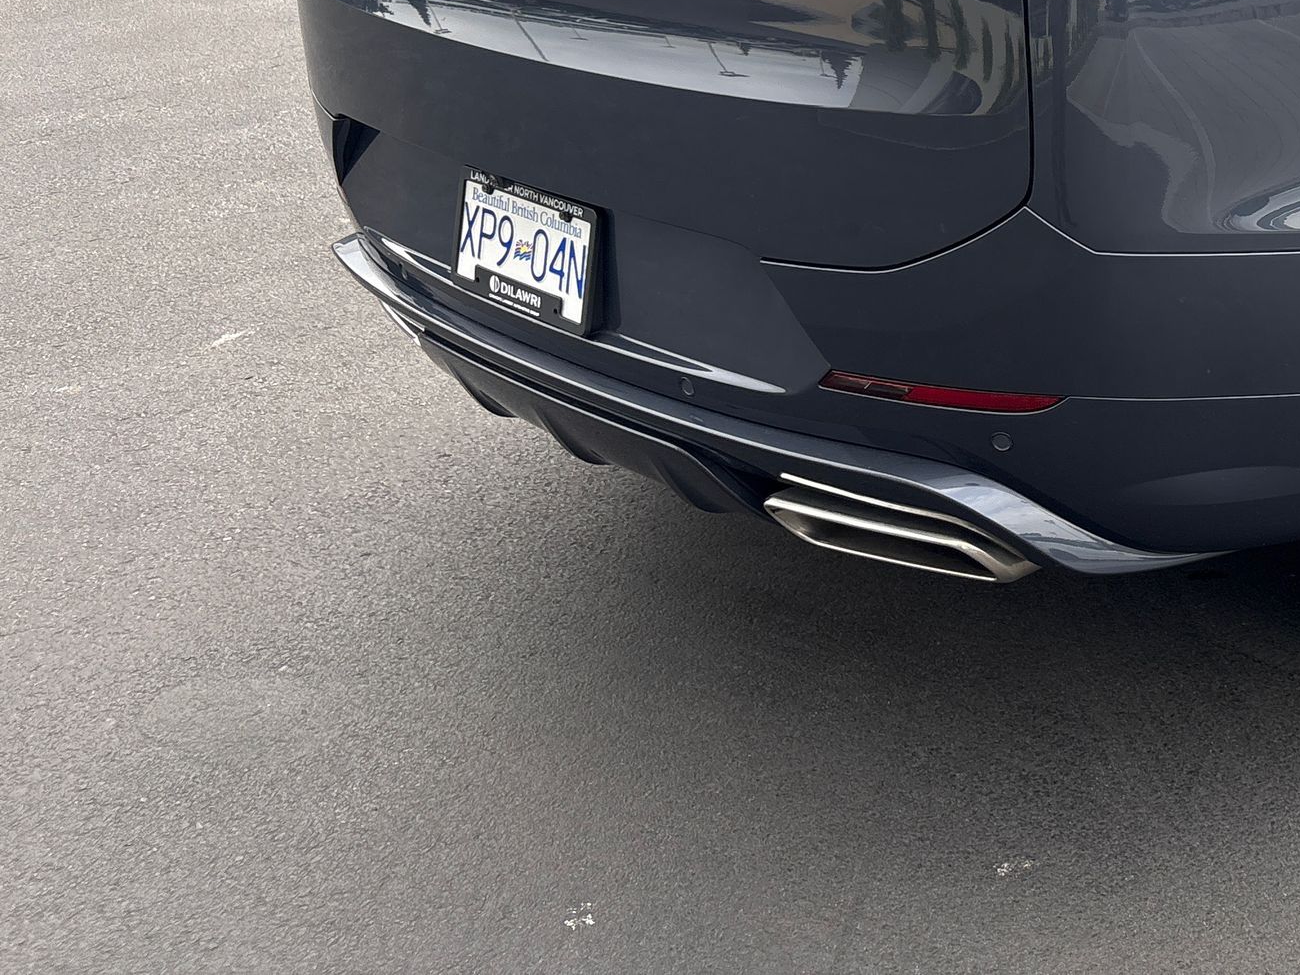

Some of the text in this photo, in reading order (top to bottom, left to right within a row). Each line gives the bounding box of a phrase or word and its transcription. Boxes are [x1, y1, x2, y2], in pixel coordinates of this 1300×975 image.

[472, 187, 582, 239] Beautiful British Columbia
[514, 186, 539, 203] NORTH
[539, 194, 583, 218] VANCOUVER
[460, 201, 587, 299] XP9 04N
[500, 281, 541, 308] DILAWRI
